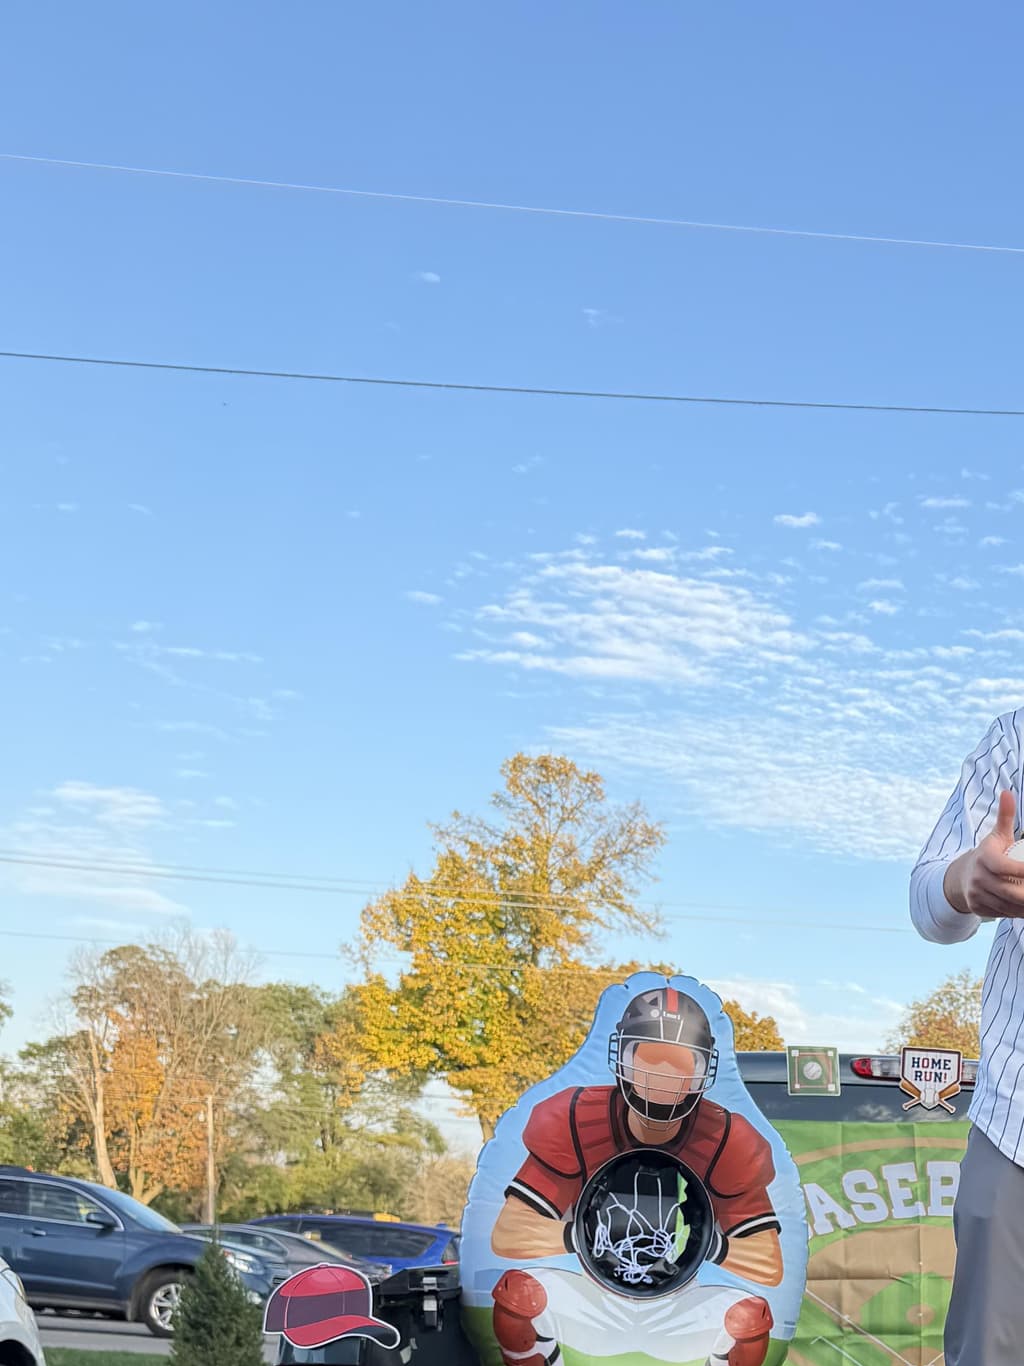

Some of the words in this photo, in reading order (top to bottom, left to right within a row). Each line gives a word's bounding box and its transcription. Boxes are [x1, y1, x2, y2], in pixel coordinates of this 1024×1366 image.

[911, 1056, 952, 1071] HOME
[914, 1070, 948, 1084] RUN!
[803, 1160, 962, 1240] ASEB
